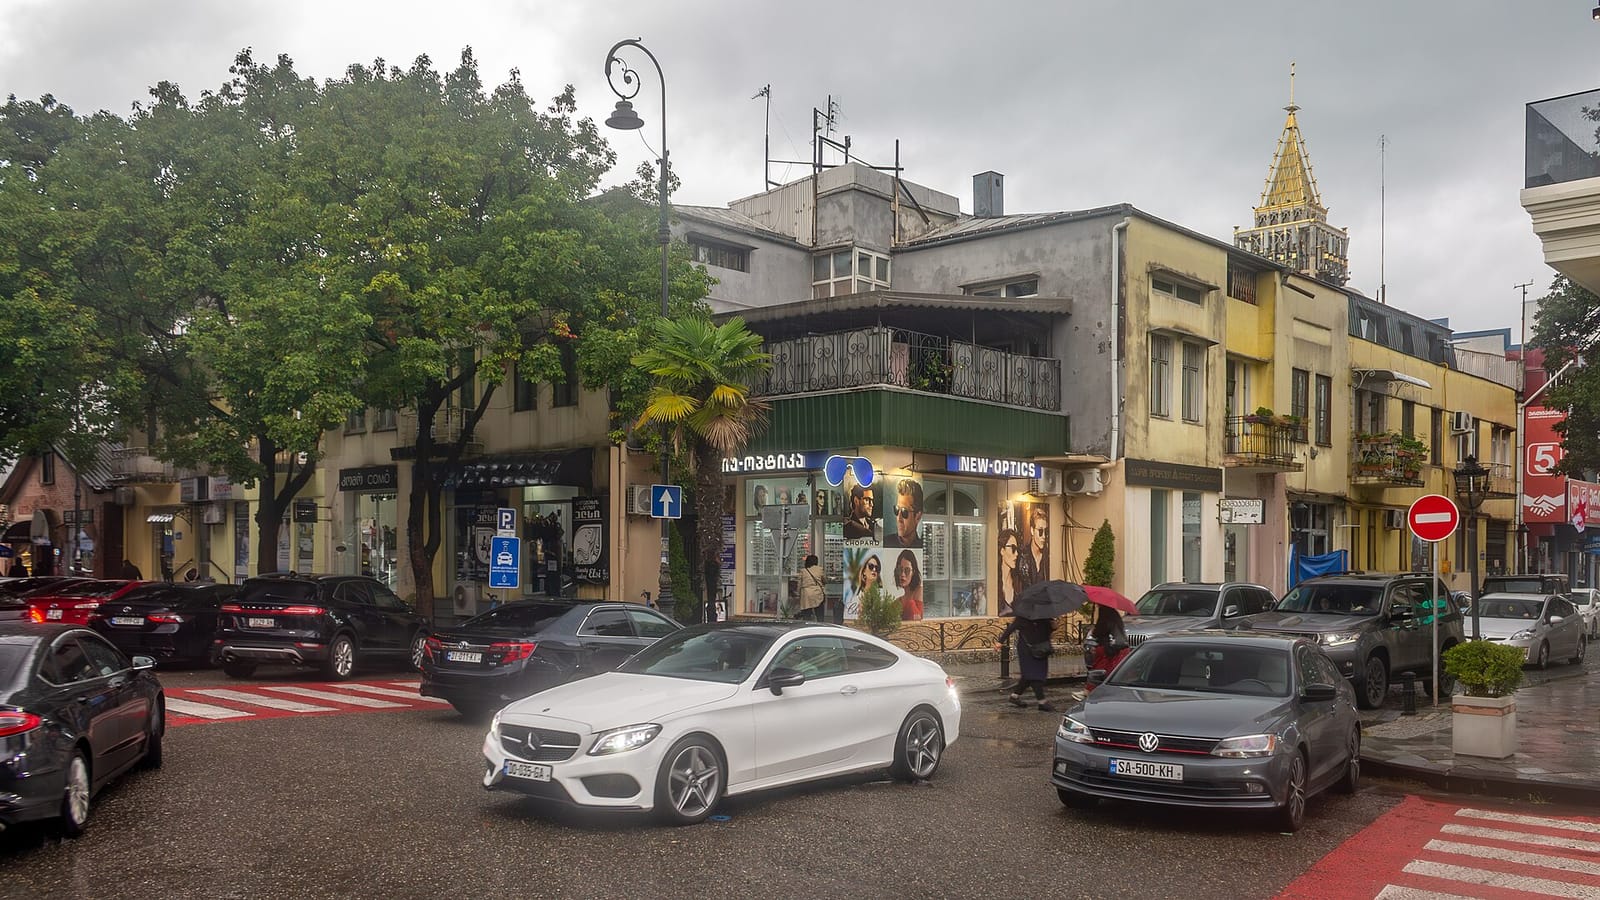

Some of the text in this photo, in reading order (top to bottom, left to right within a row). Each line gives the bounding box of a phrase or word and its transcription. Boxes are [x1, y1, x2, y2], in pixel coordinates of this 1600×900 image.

[722, 452, 805, 473] იუ-ოპტიკა
[959, 456, 1036, 477] NEW-OPTICS
[1534, 445, 1555, 473] 5
[502, 512, 511, 527] P
[845, 539, 880, 547] CHOPARD
[1118, 761, 1174, 778] SA-500-KH
